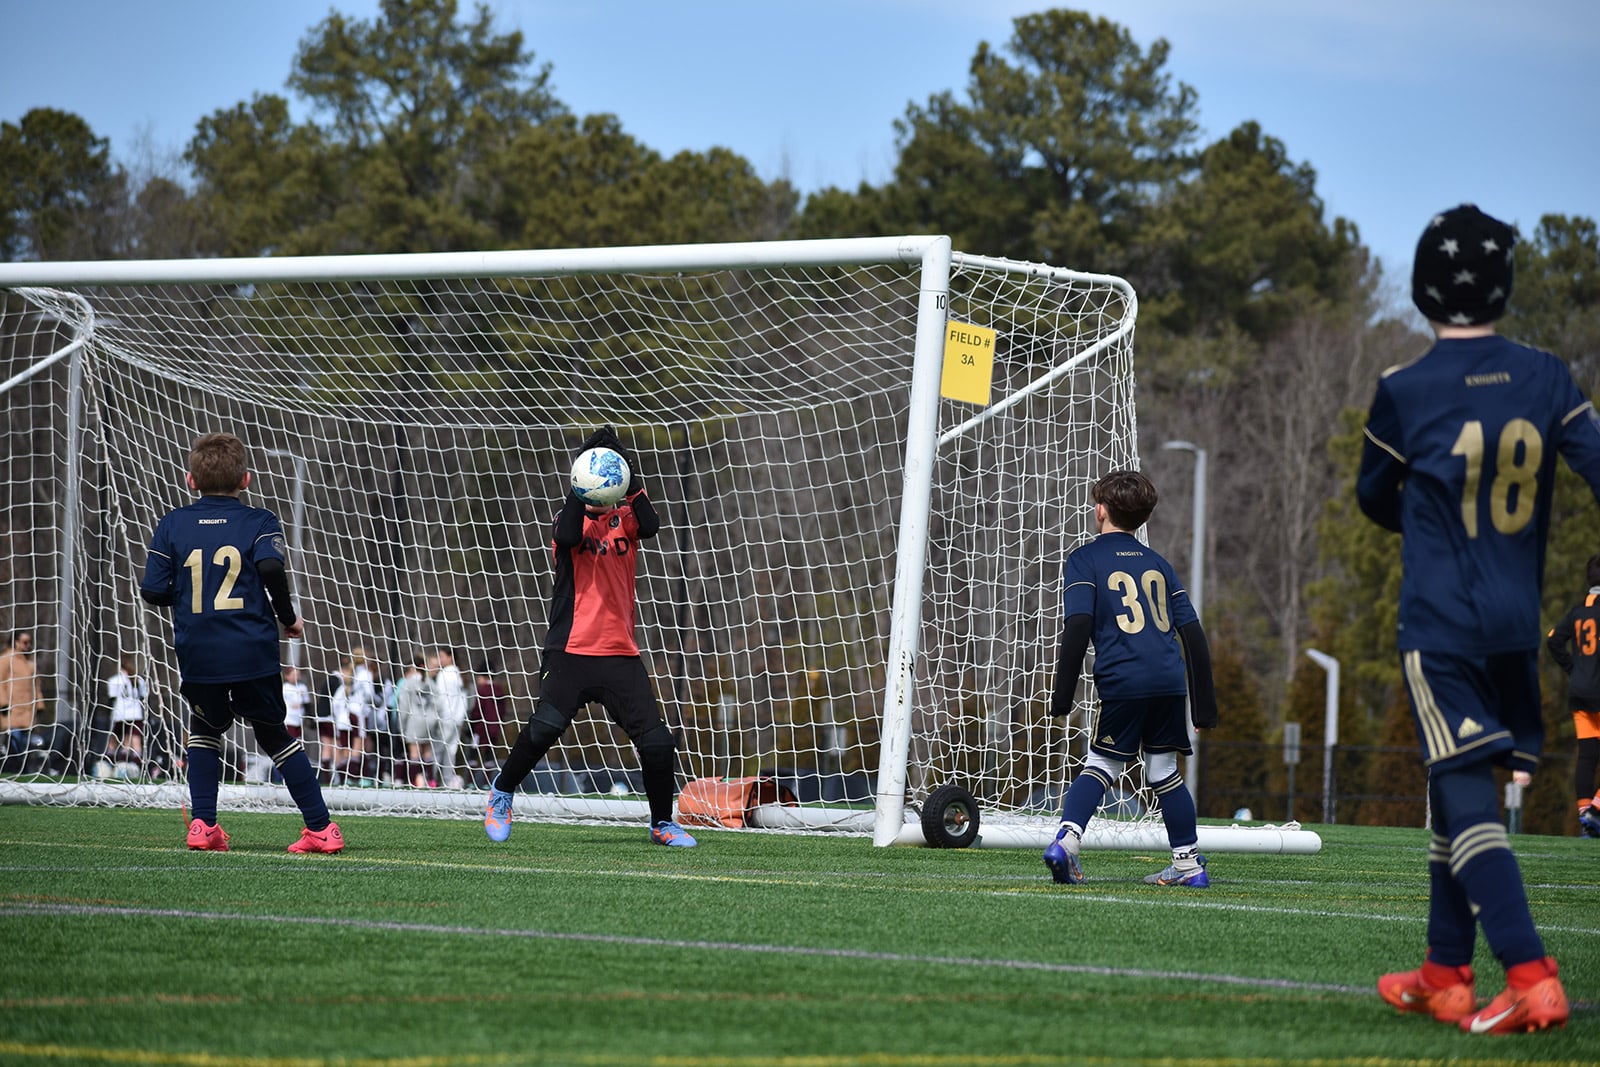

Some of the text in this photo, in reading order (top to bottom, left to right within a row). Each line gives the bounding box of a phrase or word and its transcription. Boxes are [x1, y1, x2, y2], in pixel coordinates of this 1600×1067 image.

[936, 295, 946, 310] 10
[950, 330, 991, 349] FIELD #
[961, 354, 975, 366] 3A
[1465, 371, 1511, 387] KNIGHTS
[1451, 417, 1543, 538] 18
[183, 545, 244, 614] 12
[1107, 570, 1170, 634] 30
[1575, 618, 1597, 656] 13
